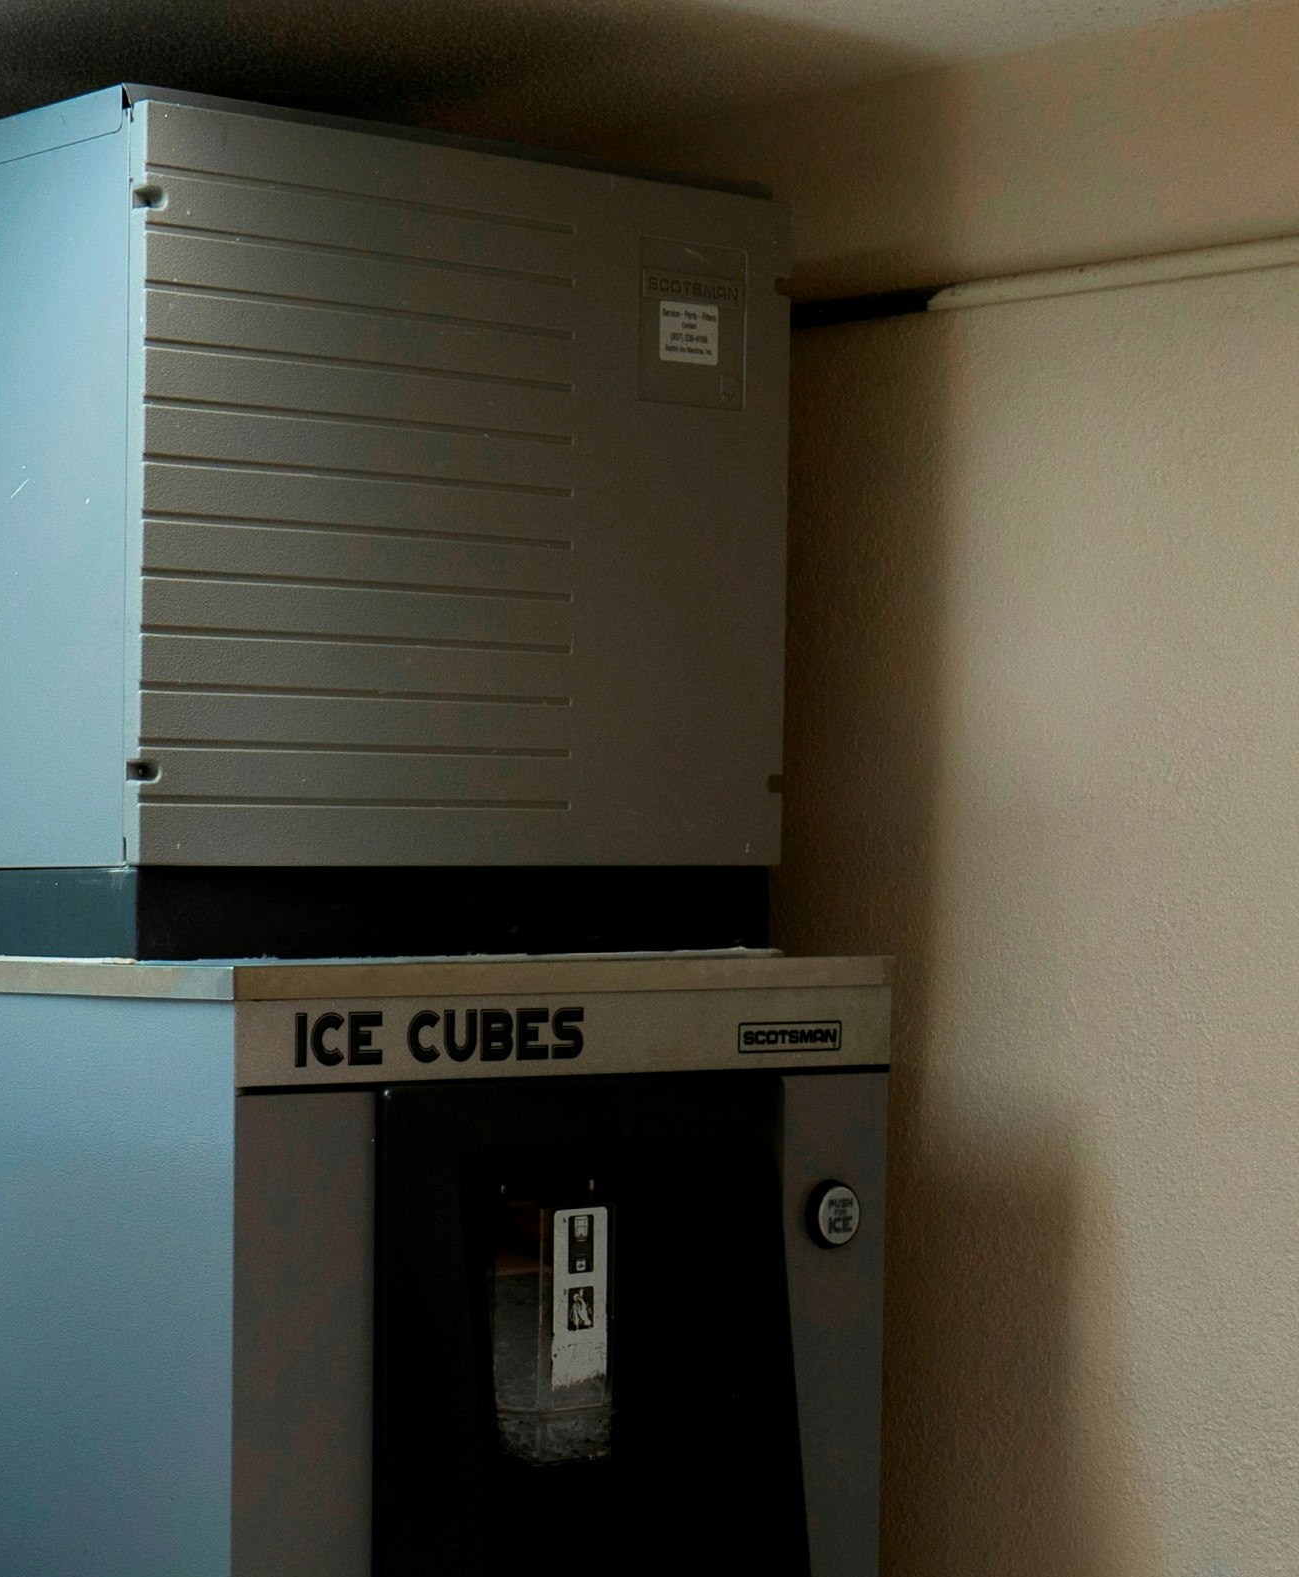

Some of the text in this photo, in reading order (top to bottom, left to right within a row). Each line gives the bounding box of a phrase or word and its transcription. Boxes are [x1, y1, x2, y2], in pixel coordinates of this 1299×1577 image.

[648, 276, 738, 306] SCOTSMAN
[295, 1007, 584, 1067] ICE CUBES
[743, 1028, 837, 1045] SCOTSMAN
[828, 1198, 853, 1209] PUSH
[828, 1216, 853, 1233] ICE
